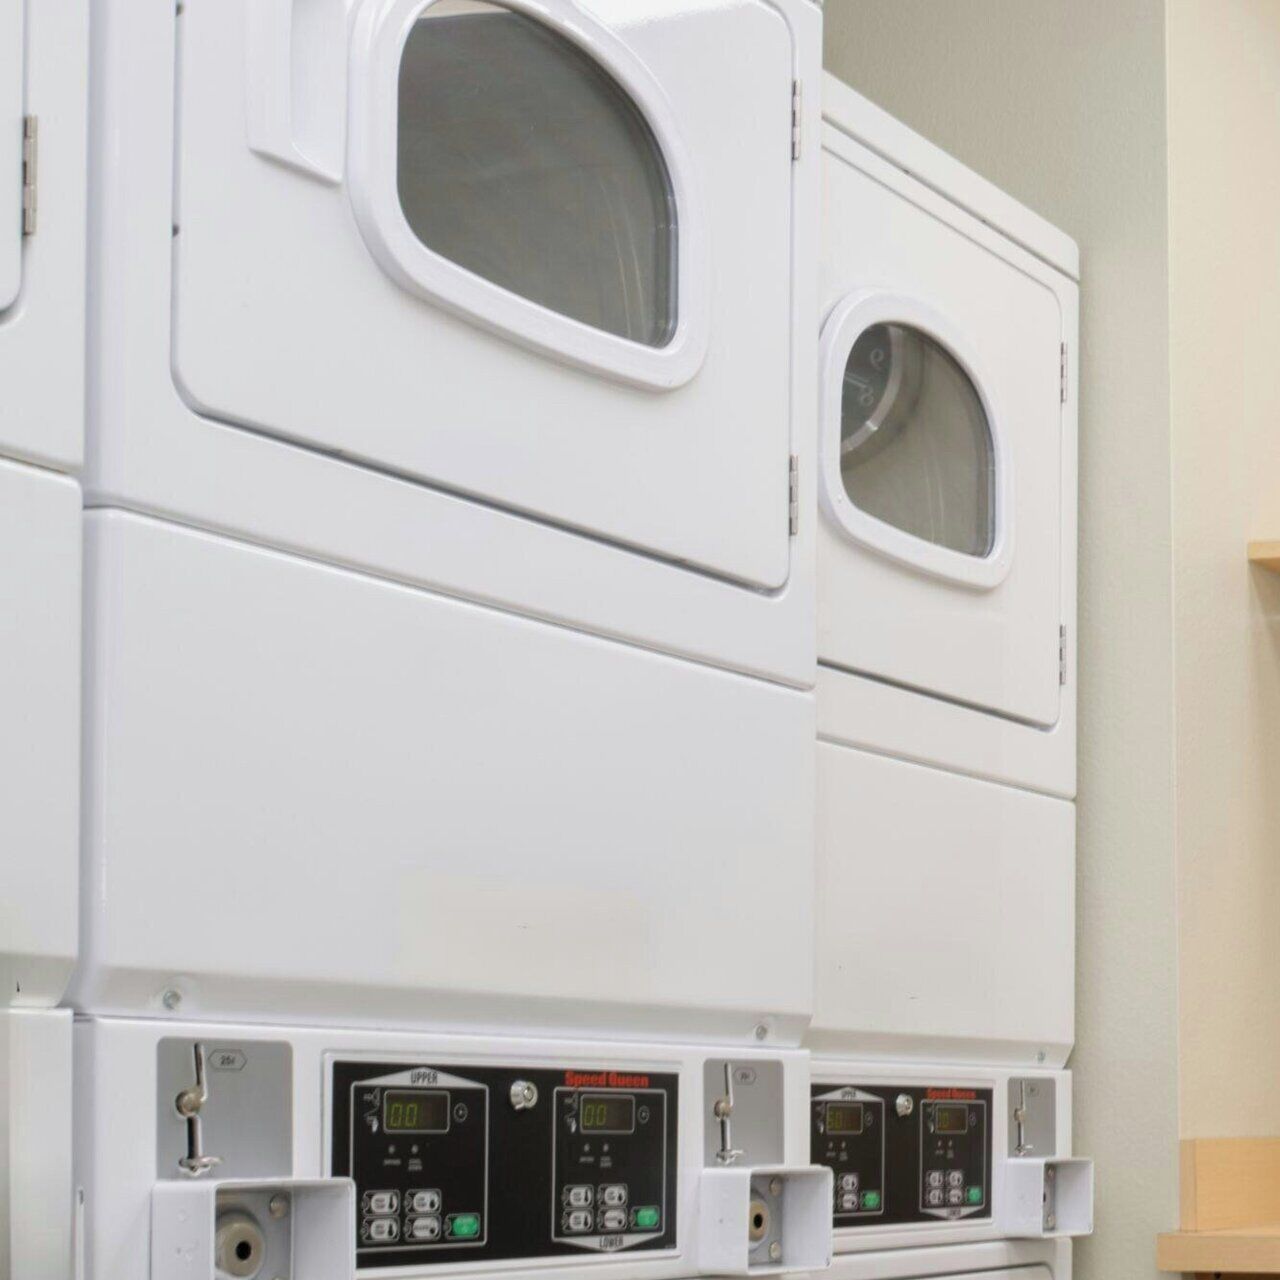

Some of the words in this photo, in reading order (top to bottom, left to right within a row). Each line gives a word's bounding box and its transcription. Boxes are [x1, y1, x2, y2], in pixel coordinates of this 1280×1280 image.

[410, 1071, 439, 1085] UPPER
[565, 1069, 607, 1088] Speed
[608, 1071, 649, 1088] Queen
[599, 1235, 624, 1249] LOWER
